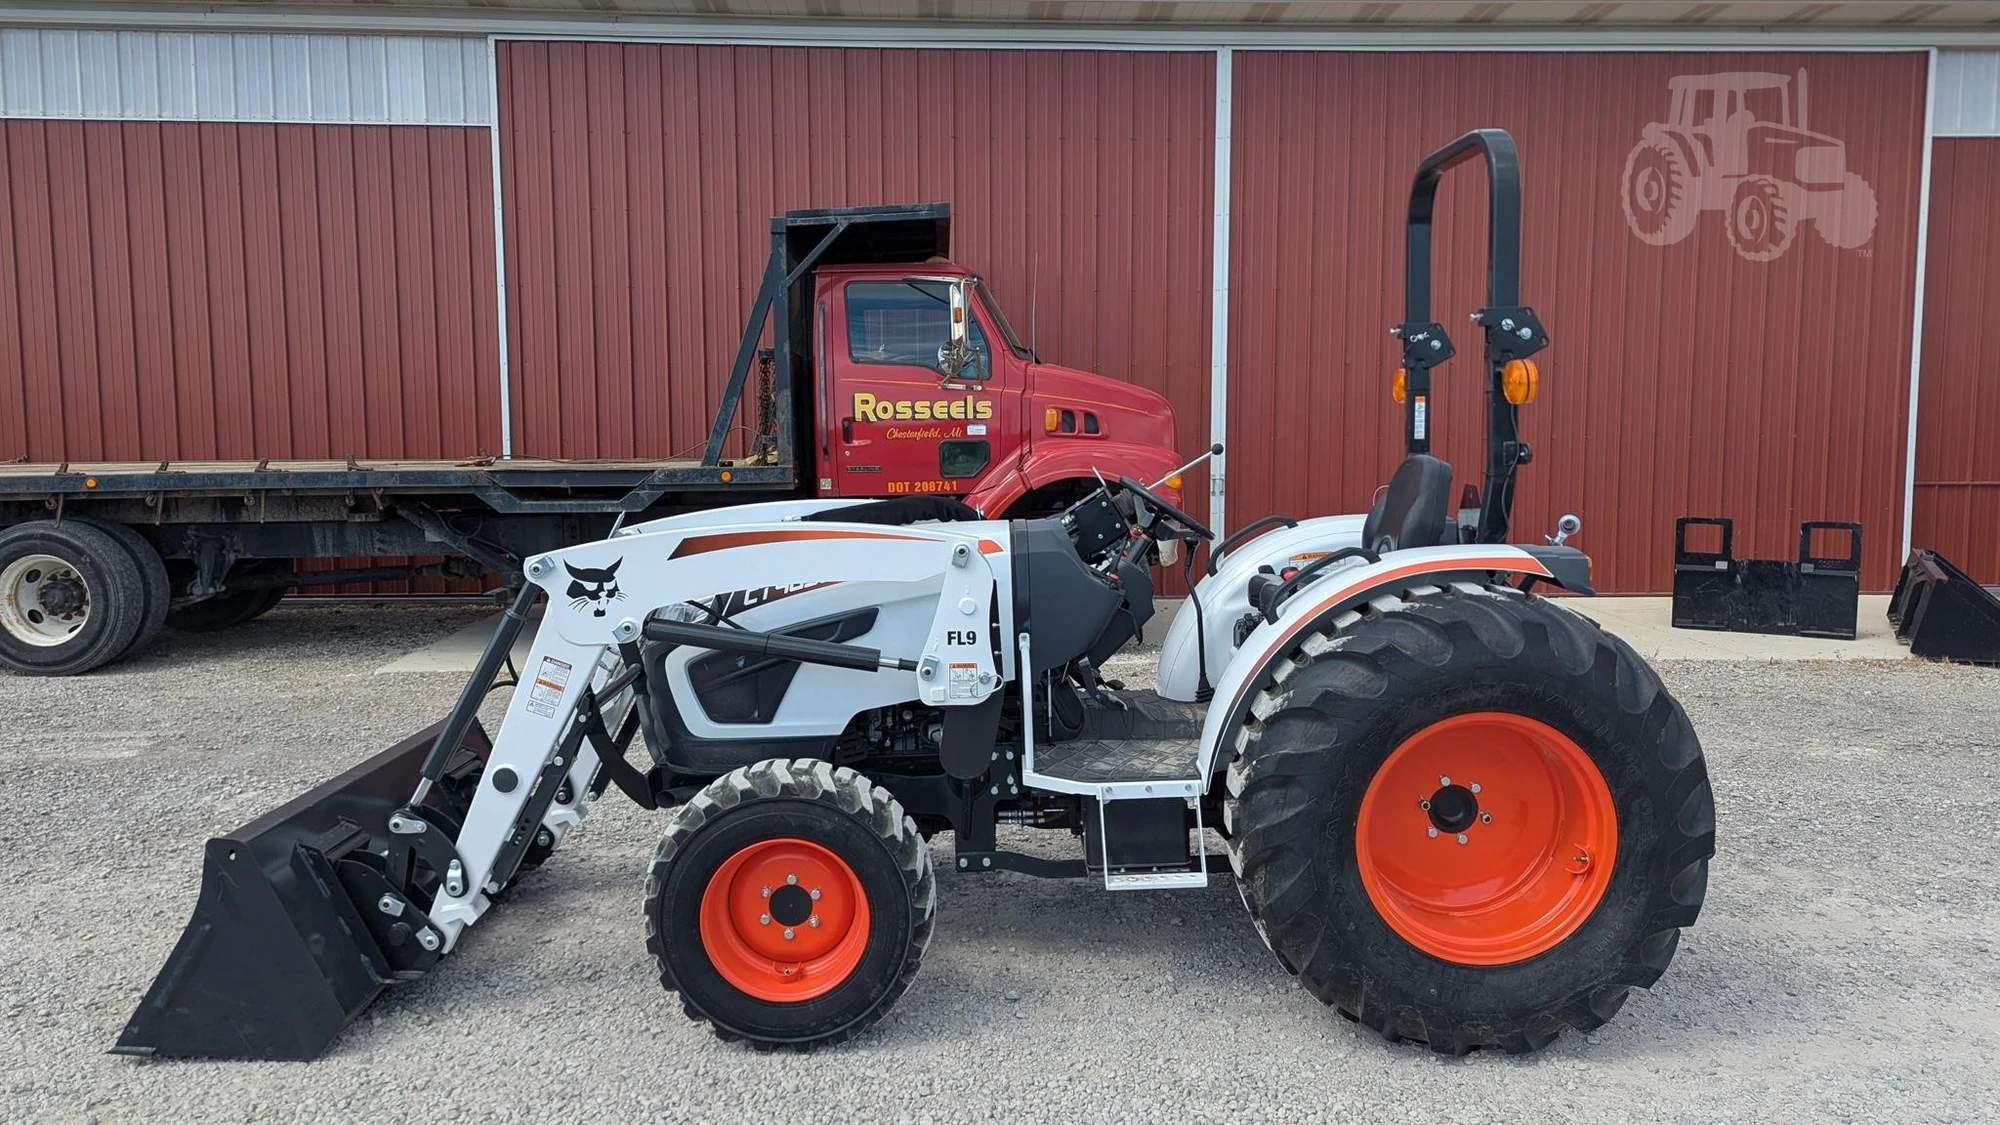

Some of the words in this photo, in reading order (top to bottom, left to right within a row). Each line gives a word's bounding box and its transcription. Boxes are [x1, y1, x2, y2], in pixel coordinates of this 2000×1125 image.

[853, 392, 993, 422] Rosseels
[887, 482, 910, 493] DOT
[914, 480, 958, 492] 208741
[947, 630, 977, 646] FL9
